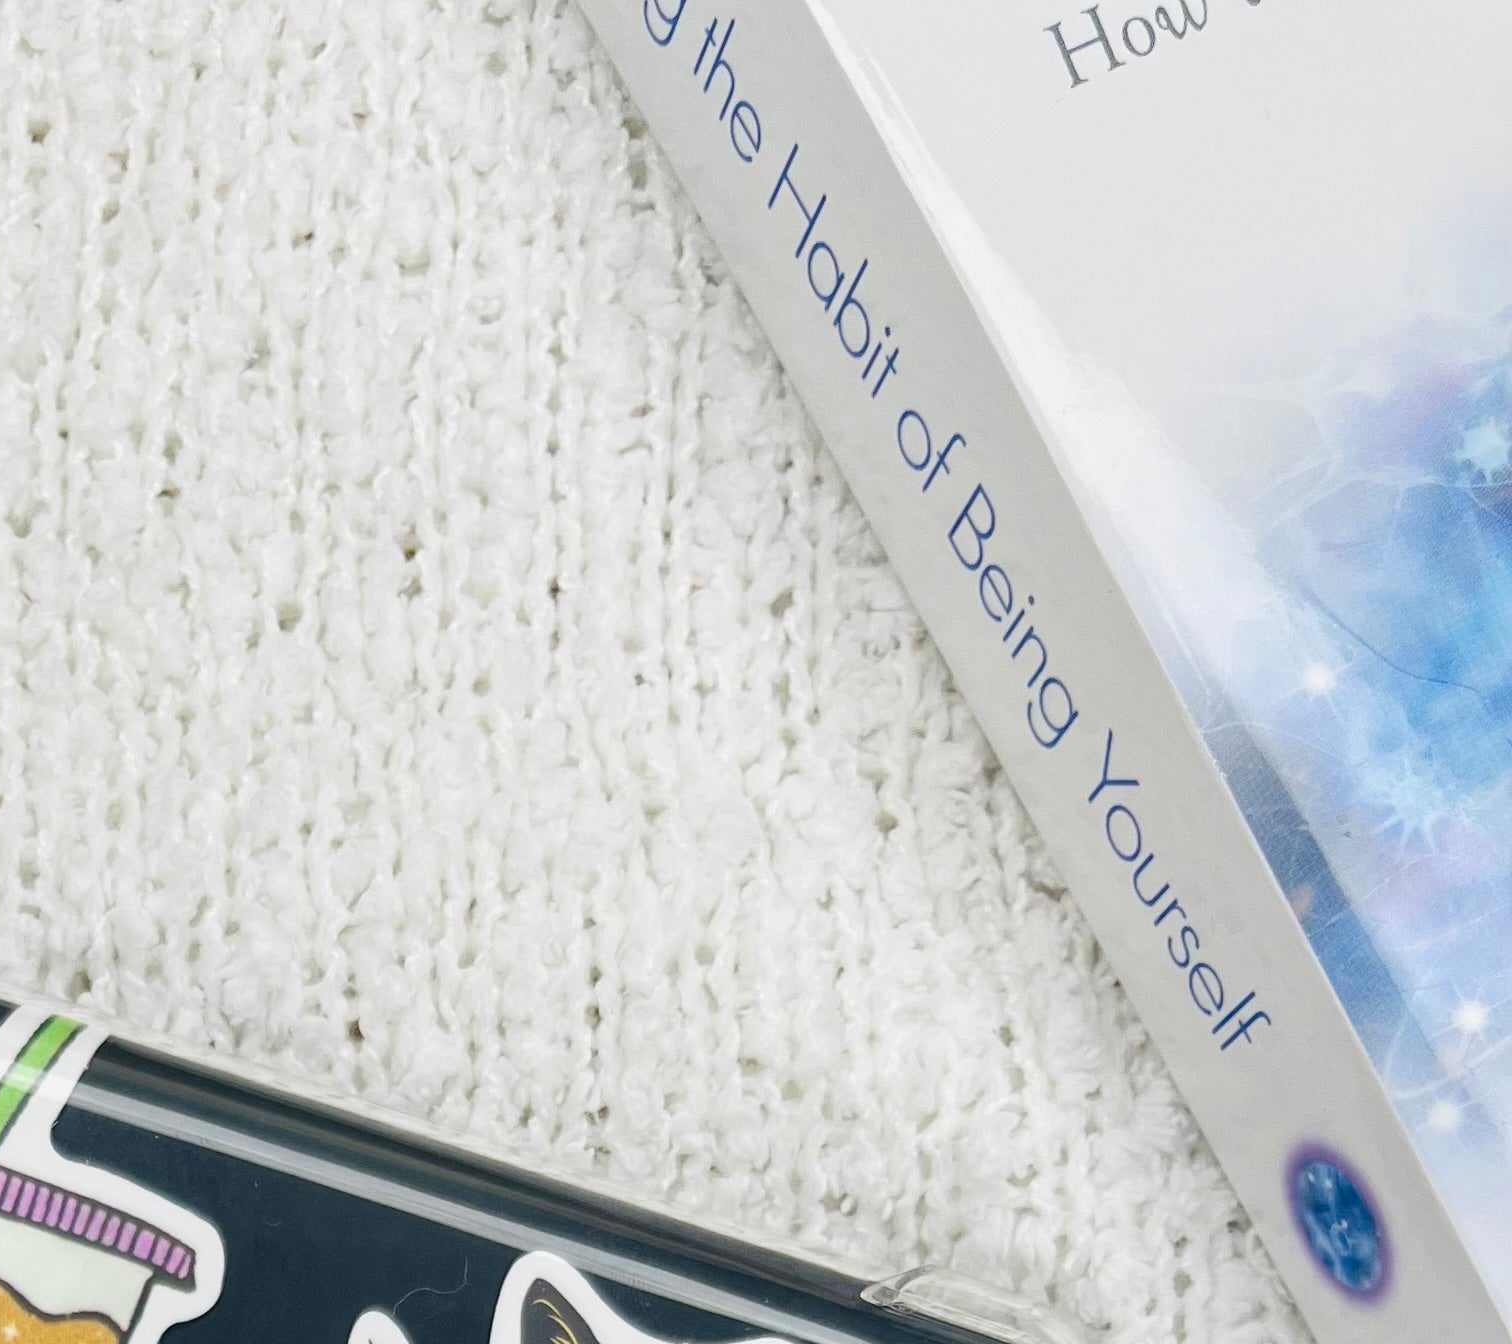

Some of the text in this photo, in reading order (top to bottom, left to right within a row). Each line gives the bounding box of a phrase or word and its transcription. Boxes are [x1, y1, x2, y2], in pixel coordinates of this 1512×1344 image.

[1044, 0, 1209, 89] How
[692, 17, 1272, 1051] the Habit of Being Yourself
